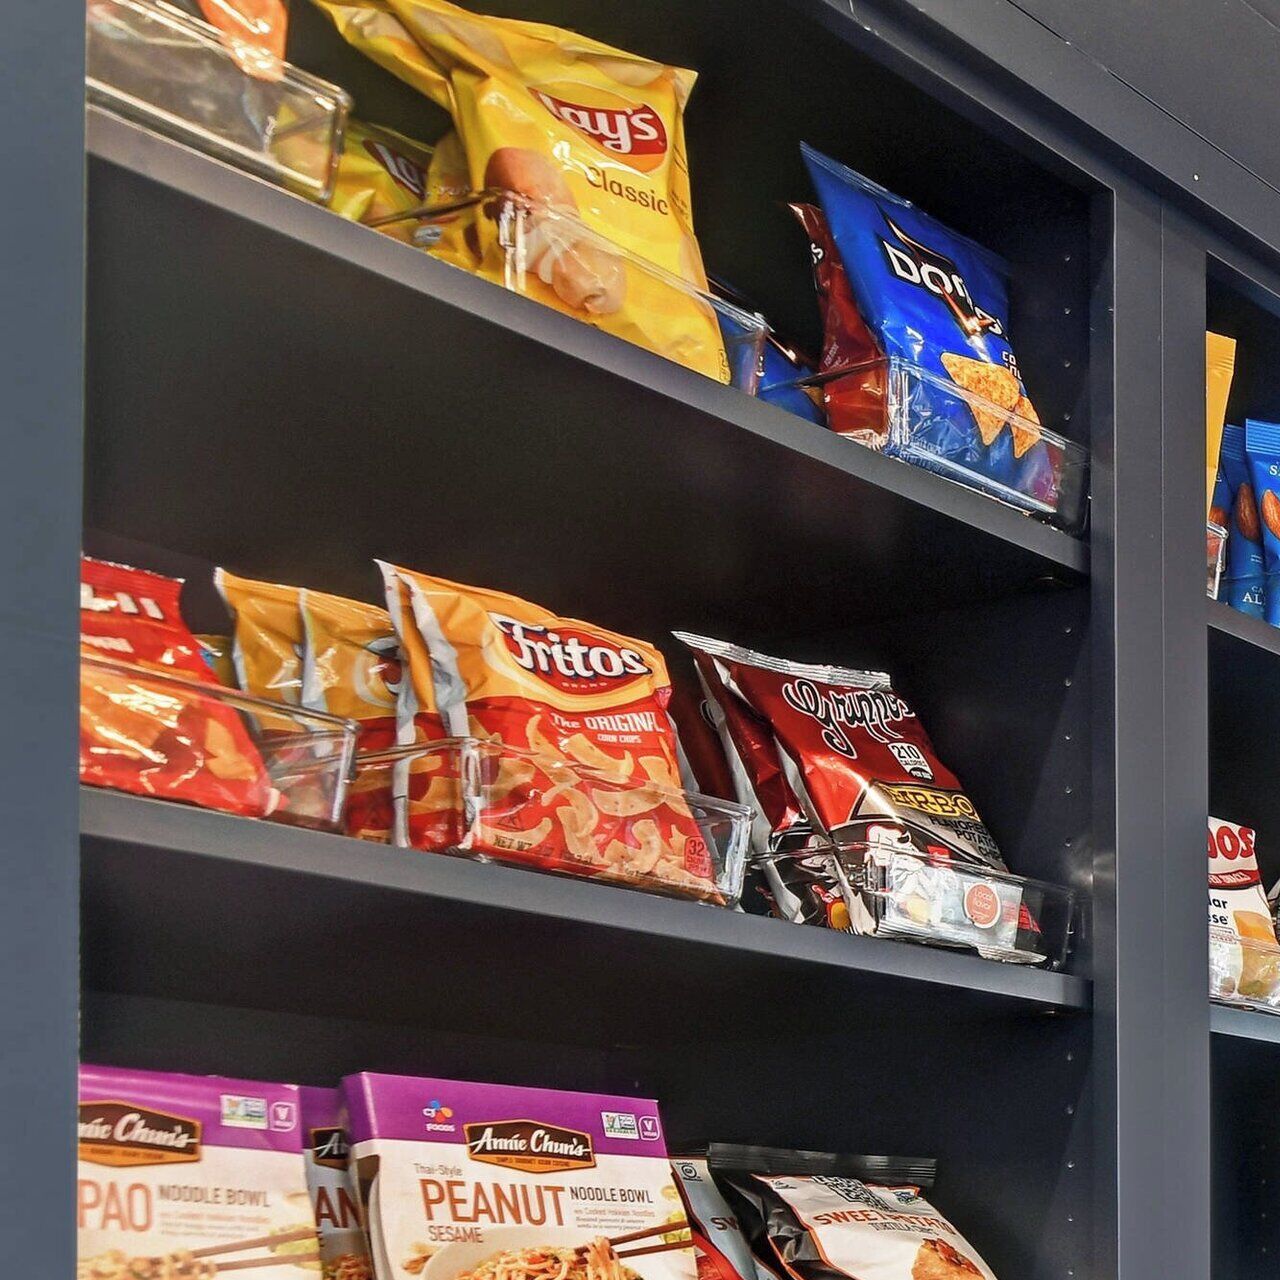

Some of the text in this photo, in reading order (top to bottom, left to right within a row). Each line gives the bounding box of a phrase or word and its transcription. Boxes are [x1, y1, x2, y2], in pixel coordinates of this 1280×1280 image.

[585, 166, 669, 215] Classic
[487, 612, 653, 677] Fritos
[584, 711, 665, 734] ORIGINAL
[892, 745, 920, 759] 210
[467, 1127, 592, 1156] Annie Chun's
[413, 1163, 463, 1176] Thai-Style
[158, 1184, 271, 1208] NOODLE BOWL
[419, 1178, 565, 1226] PEANUT
[570, 1186, 653, 1204] NOODLE BOWL
[812, 1208, 881, 1226] SWEET
[428, 1224, 484, 1244] SESAME
